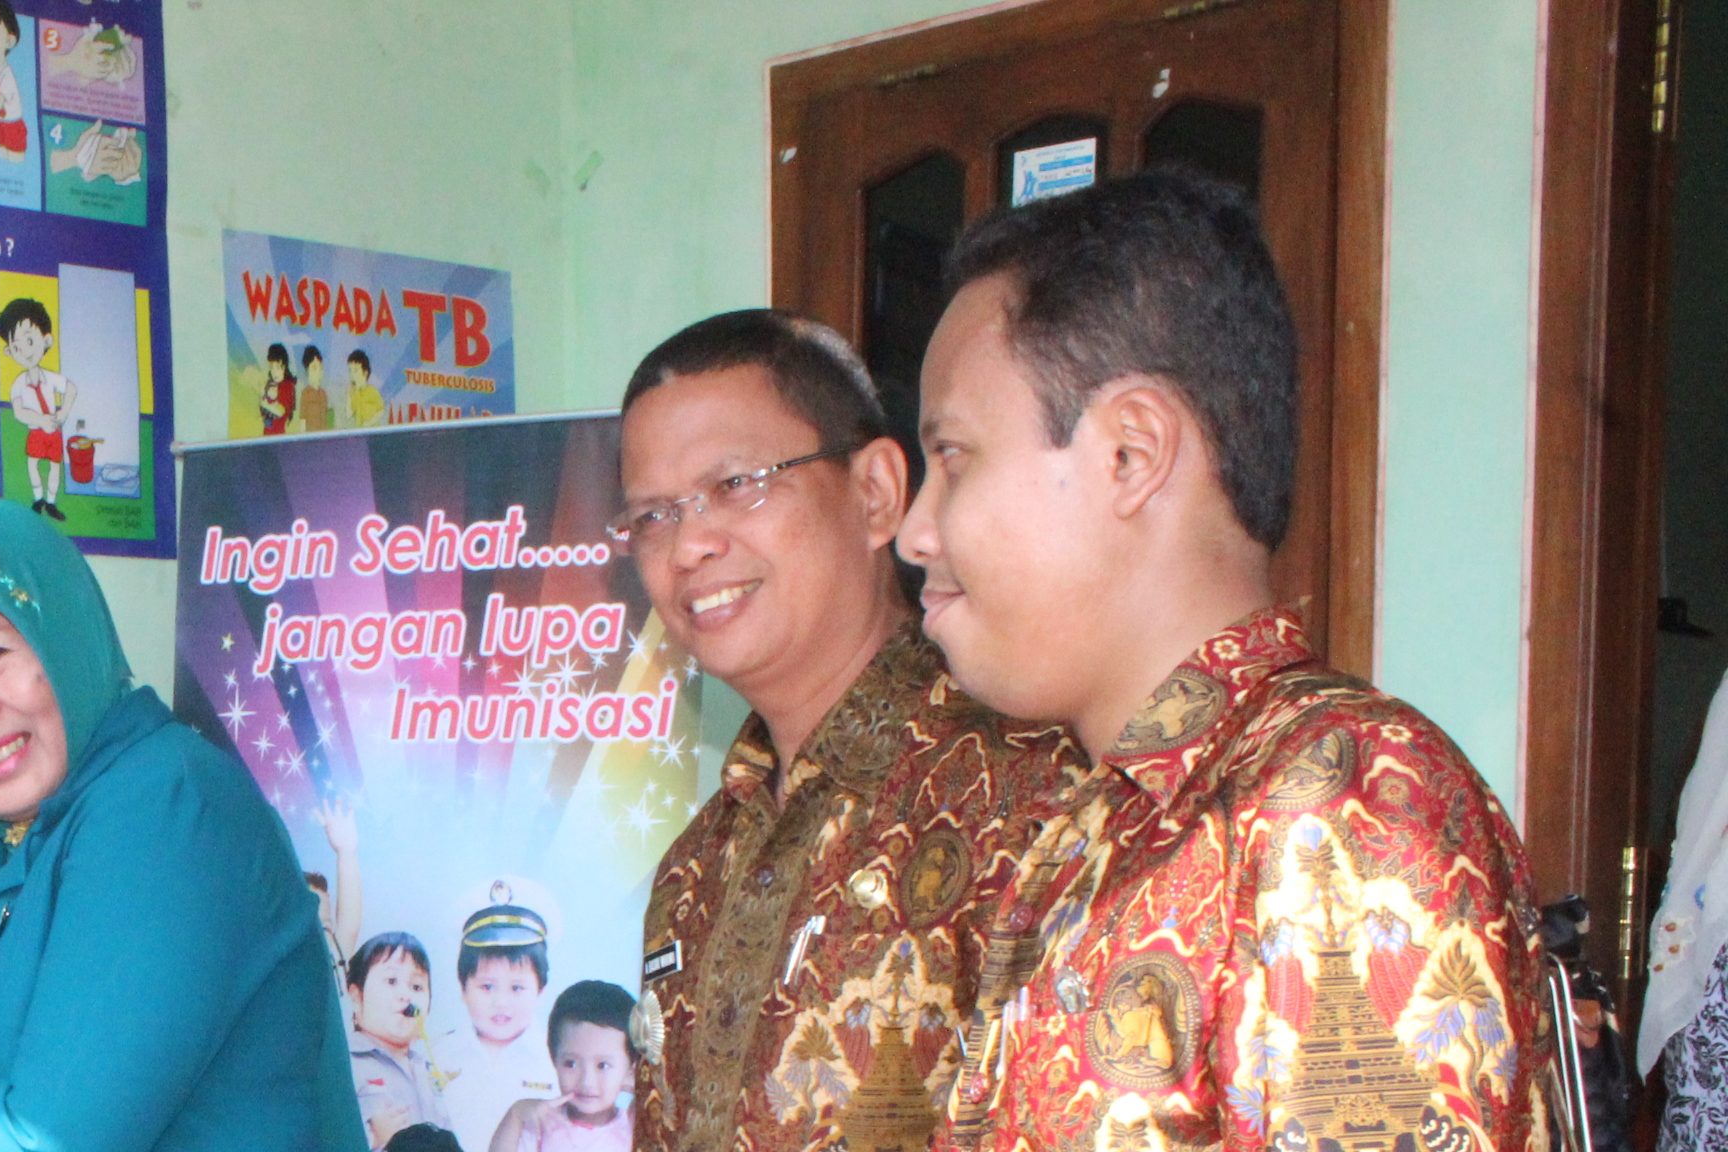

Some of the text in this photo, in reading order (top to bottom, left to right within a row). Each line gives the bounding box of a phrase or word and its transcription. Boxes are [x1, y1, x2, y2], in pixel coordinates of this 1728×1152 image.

[45, 28, 60, 50] 3
[50, 125, 63, 144] 4
[5, 238, 15, 257] ?
[242, 270, 397, 338] WASPADA
[402, 289, 493, 368] TB
[404, 369, 495, 393] TUBERCULOSIS
[201, 519, 338, 594] Ingin
[254, 593, 626, 678] jangan lupa
[390, 677, 678, 745] Imunisasi
